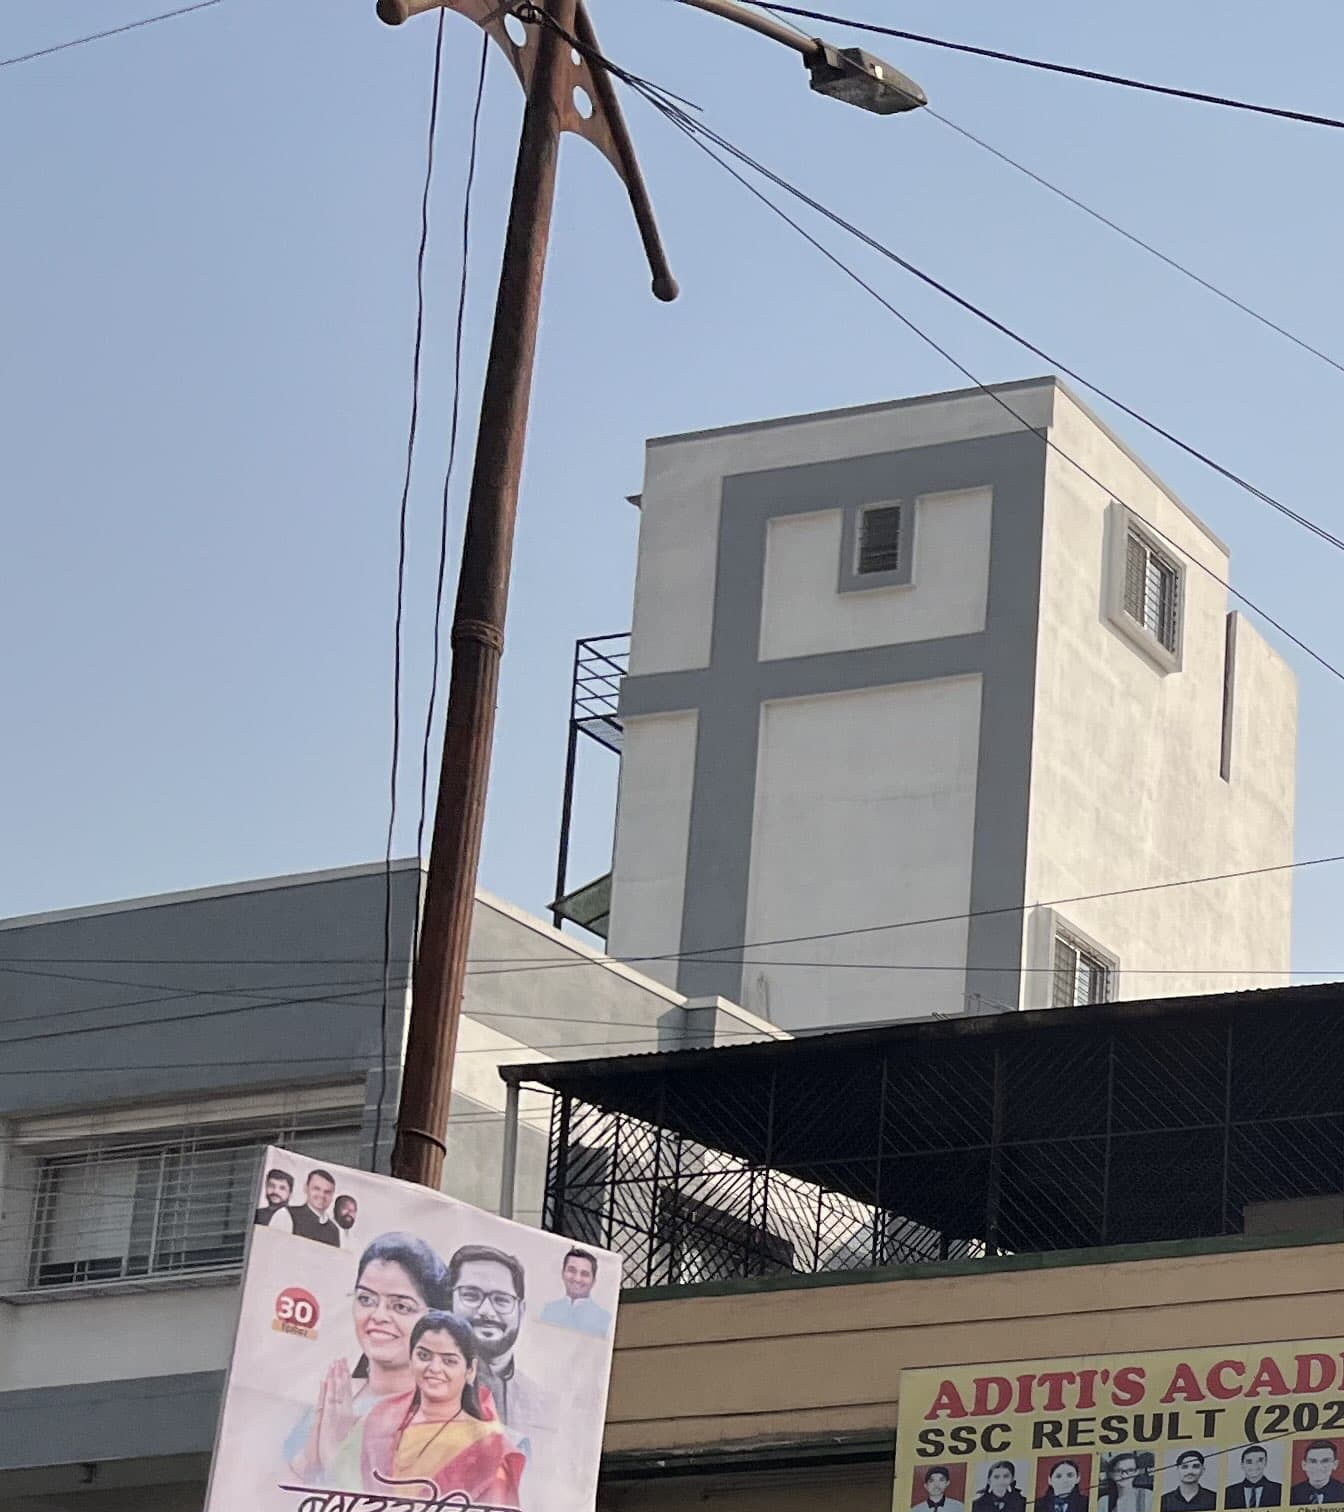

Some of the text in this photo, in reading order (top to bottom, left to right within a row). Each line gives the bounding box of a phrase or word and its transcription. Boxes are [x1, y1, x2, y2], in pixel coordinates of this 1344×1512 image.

[278, 1296, 313, 1323] 30
[924, 1366, 1147, 1420] ADITI'S
[916, 1423, 1012, 1458] SSC
[1031, 1408, 1226, 1450] RESULT
